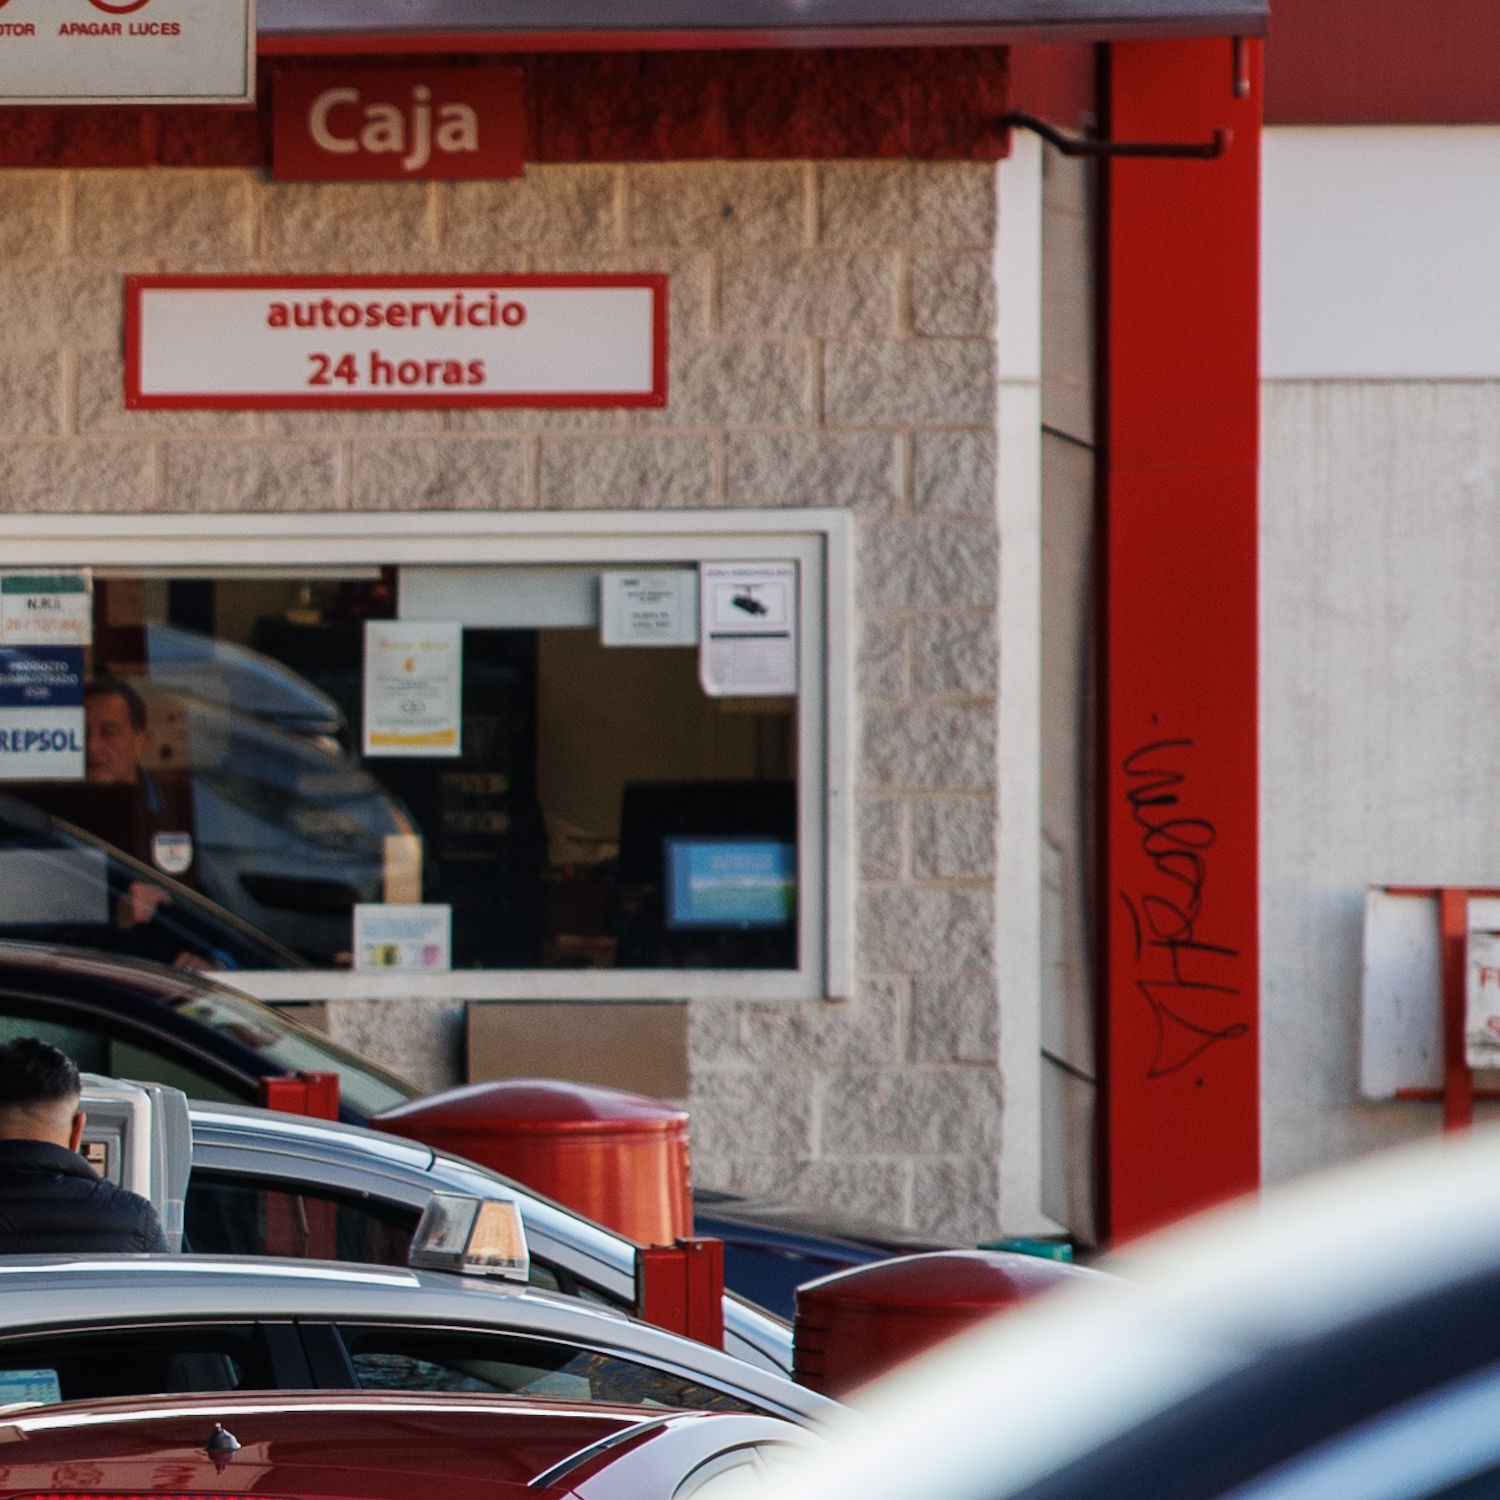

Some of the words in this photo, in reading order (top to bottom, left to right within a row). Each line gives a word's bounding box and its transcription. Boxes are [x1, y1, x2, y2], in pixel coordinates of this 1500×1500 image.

[59, 22, 122, 37] APAGAR
[130, 22, 181, 36] LUCES
[309, 85, 478, 171] Caja
[267, 293, 527, 328] autoservicio
[308, 353, 357, 385] 24
[371, 351, 486, 385] horas
